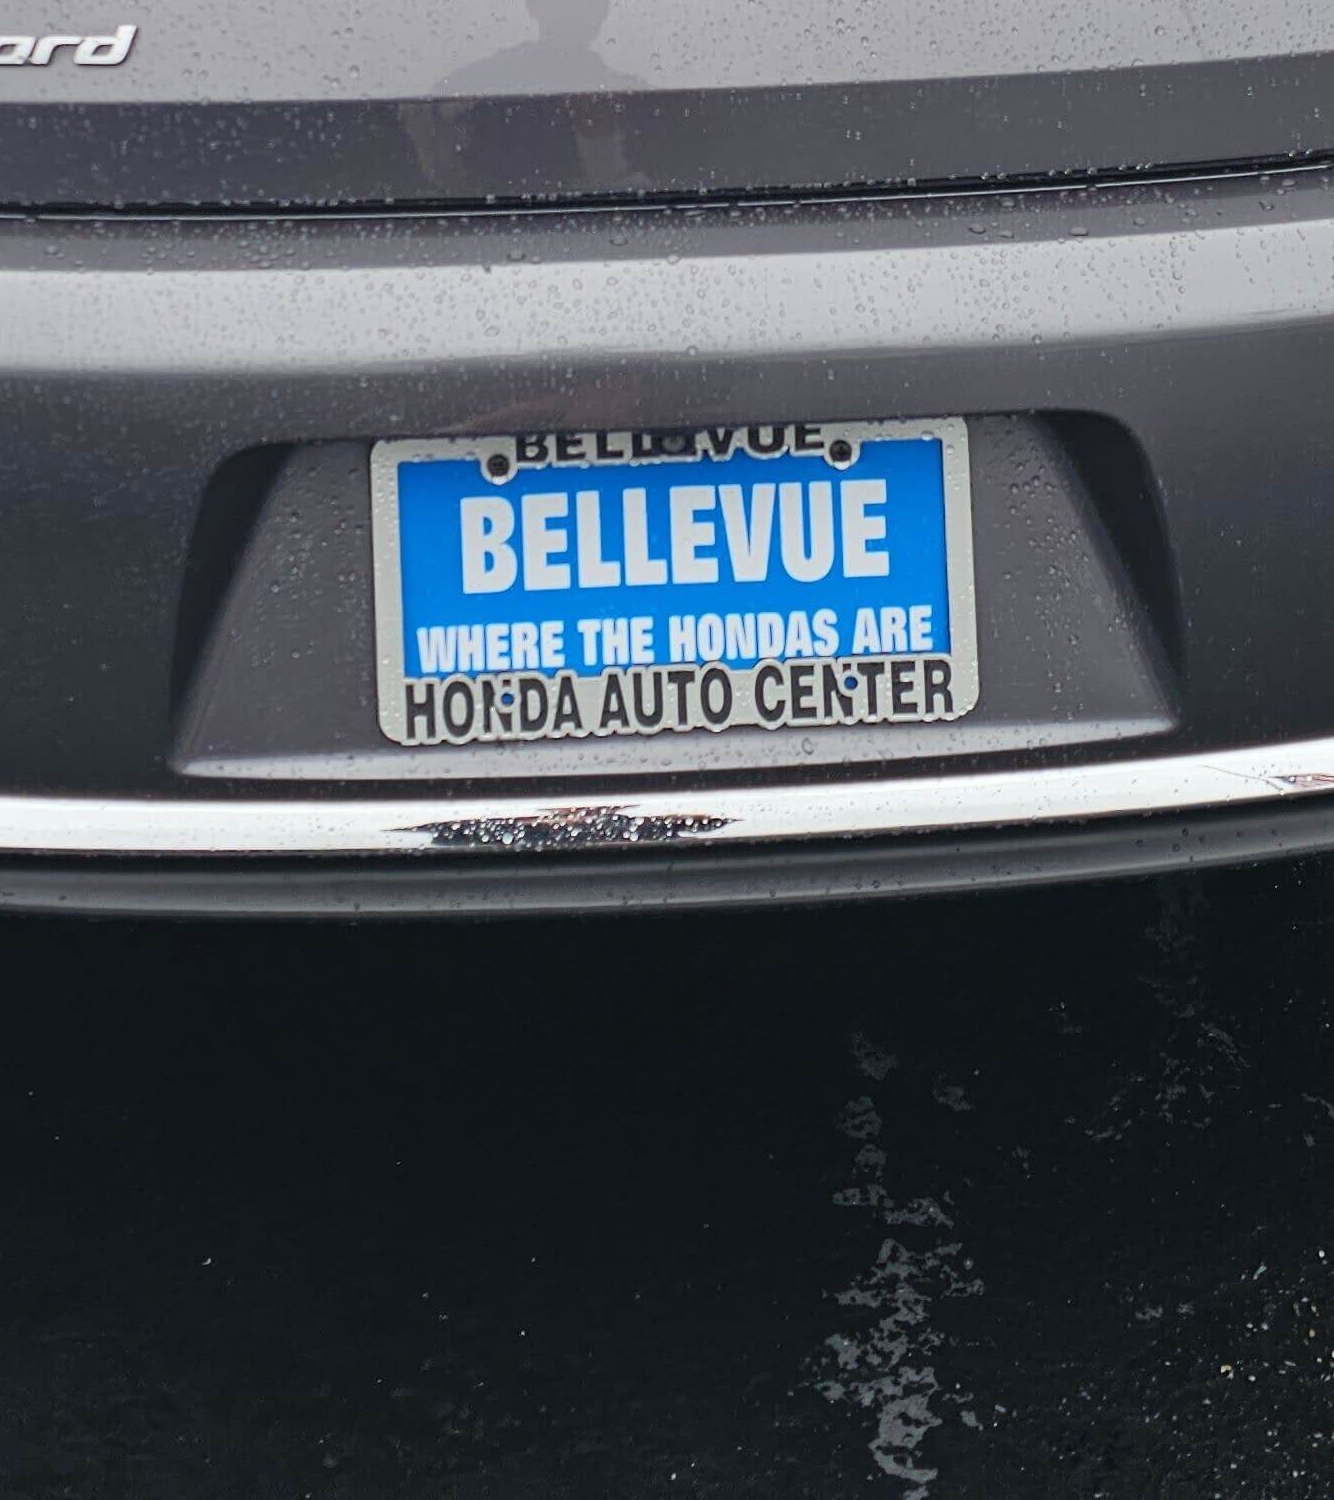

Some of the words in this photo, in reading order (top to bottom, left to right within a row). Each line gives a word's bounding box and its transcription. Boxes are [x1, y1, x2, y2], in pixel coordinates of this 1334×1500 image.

[460, 478, 890, 595] BELLEVUE
[416, 619, 565, 674] WHERE
[576, 615, 655, 667] THE
[668, 608, 840, 663] HONDAS
[851, 604, 934, 654] ARE
[404, 672, 585, 741] HONDA
[599, 666, 734, 731] AUTO
[753, 657, 955, 721] CENTER
